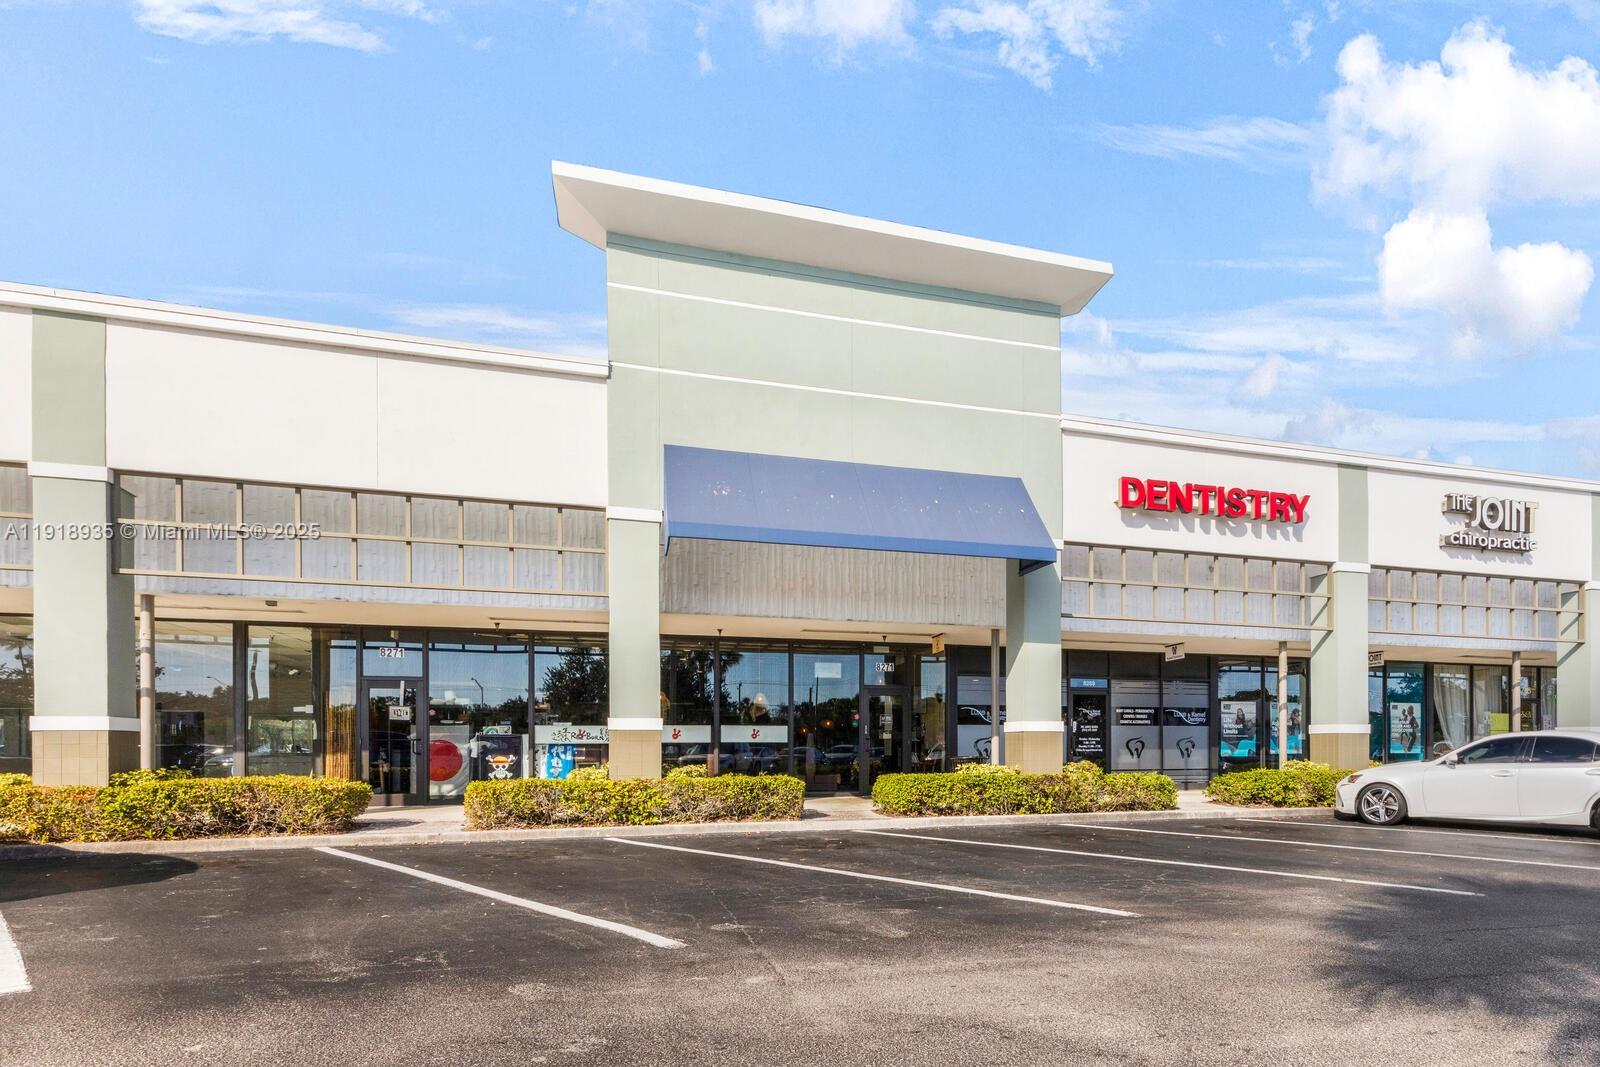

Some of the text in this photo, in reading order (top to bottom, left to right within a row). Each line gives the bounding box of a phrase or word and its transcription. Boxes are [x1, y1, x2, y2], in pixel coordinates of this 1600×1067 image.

[1119, 476, 1311, 524] DENTISTRY
[1450, 494, 1539, 533] THE JOINT
[1450, 531, 1537, 551] chiropractic
[380, 648, 404, 658] 8271
[1368, 653, 1382, 662] OINT
[876, 663, 894, 672] 8271
